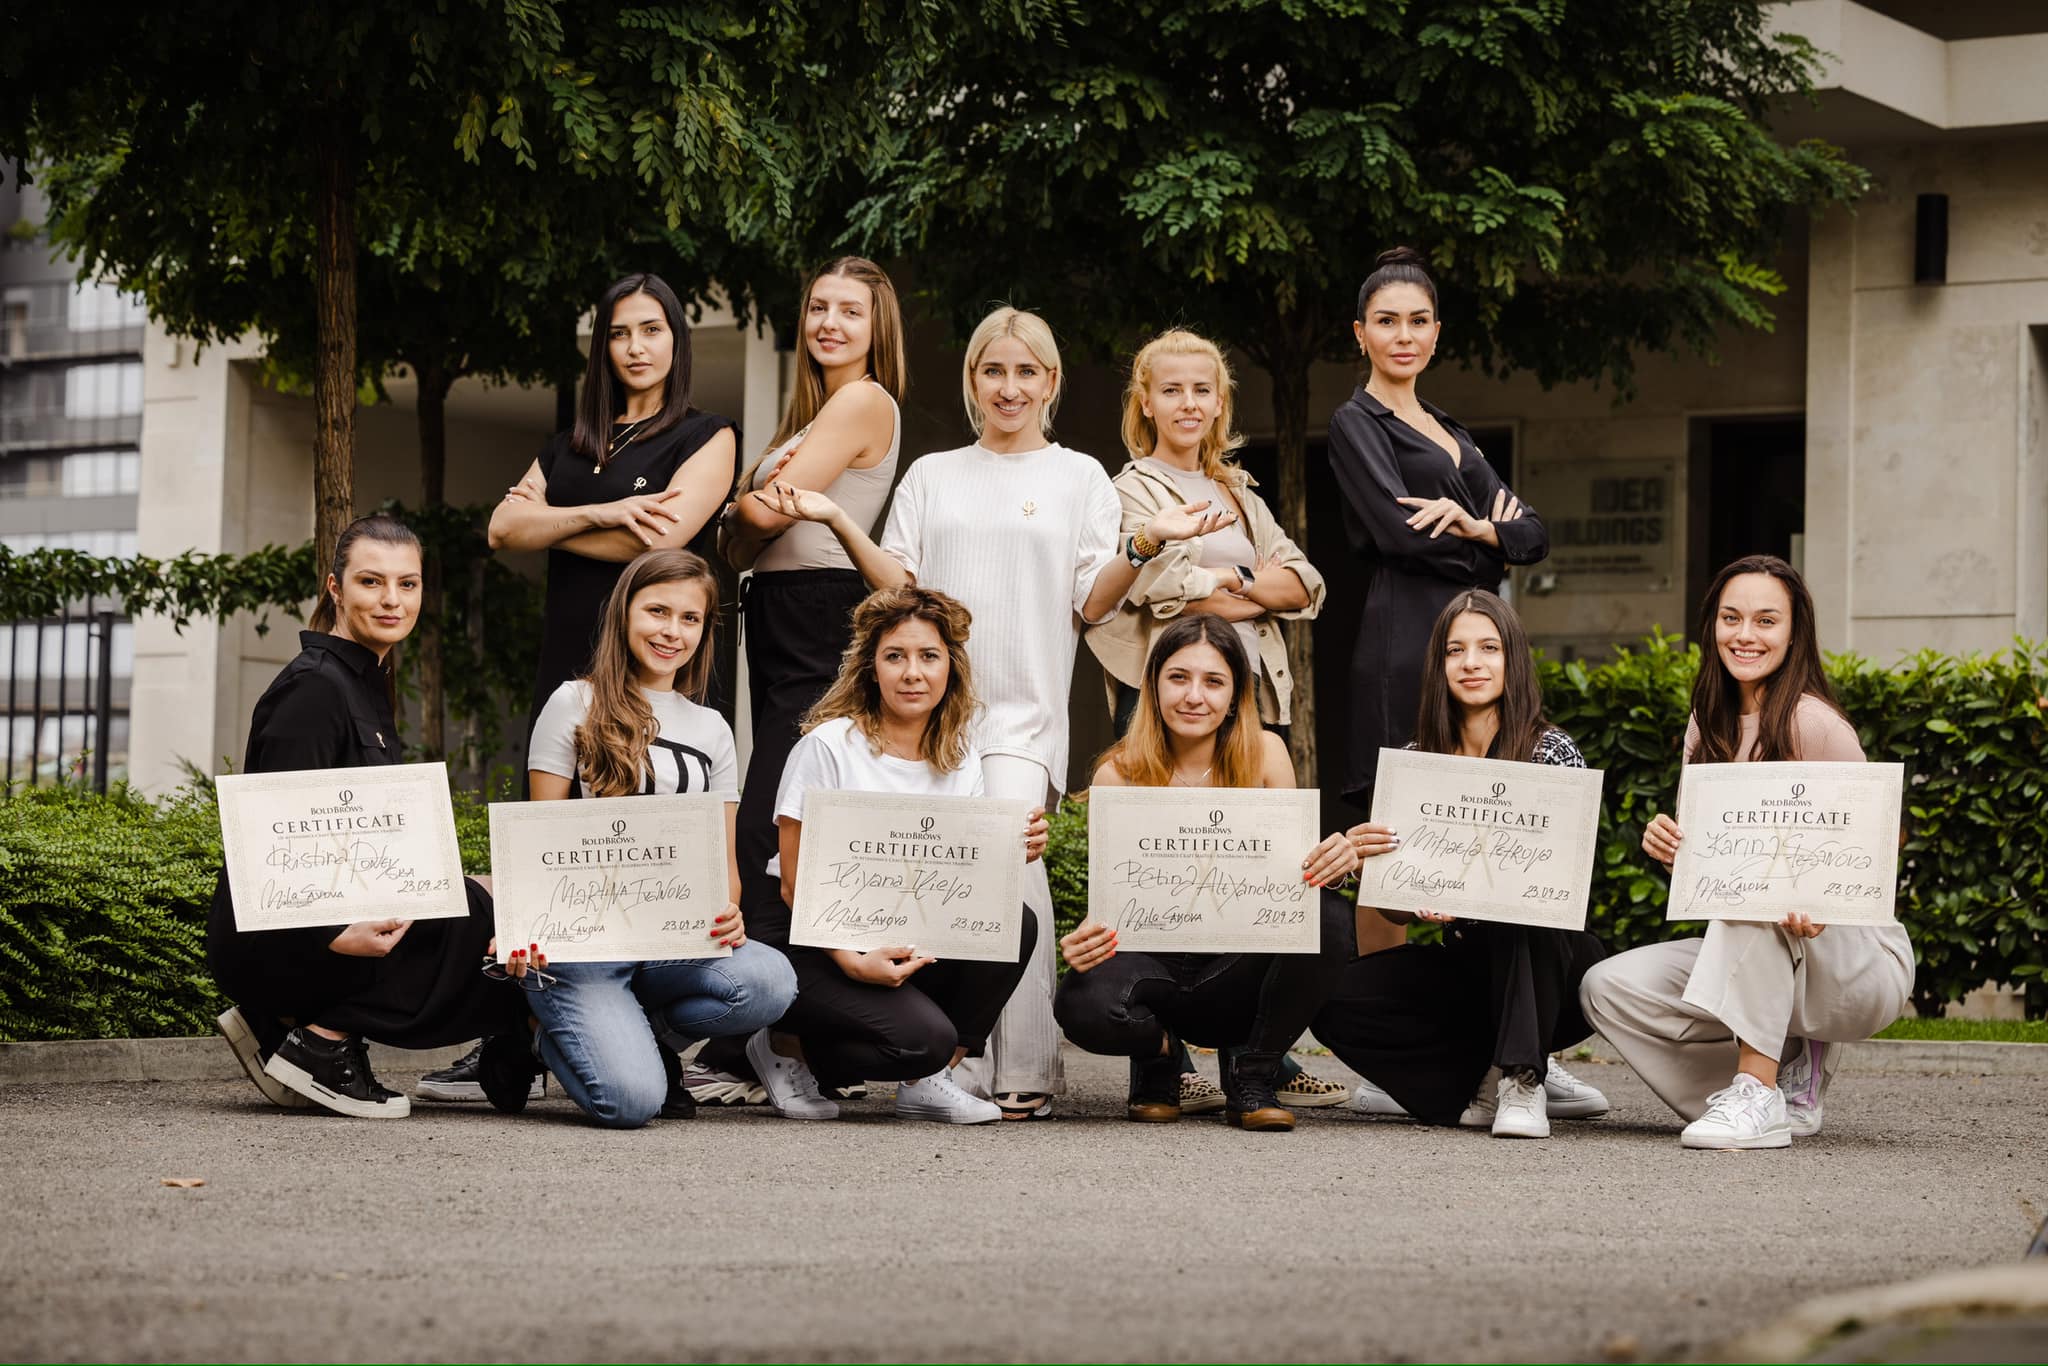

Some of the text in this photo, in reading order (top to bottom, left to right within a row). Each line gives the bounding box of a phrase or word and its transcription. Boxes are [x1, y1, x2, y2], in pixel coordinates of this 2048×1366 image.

[272, 813, 406, 835] CERTIFICATE
[1420, 802, 1551, 829] CERTIFICATE
[1722, 810, 1852, 826] CERTIFICATE
[849, 840, 980, 860] CERTIFICATE
[1138, 838, 1273, 852] CERTIFICATE
[542, 845, 678, 866] CERTIFICATE
